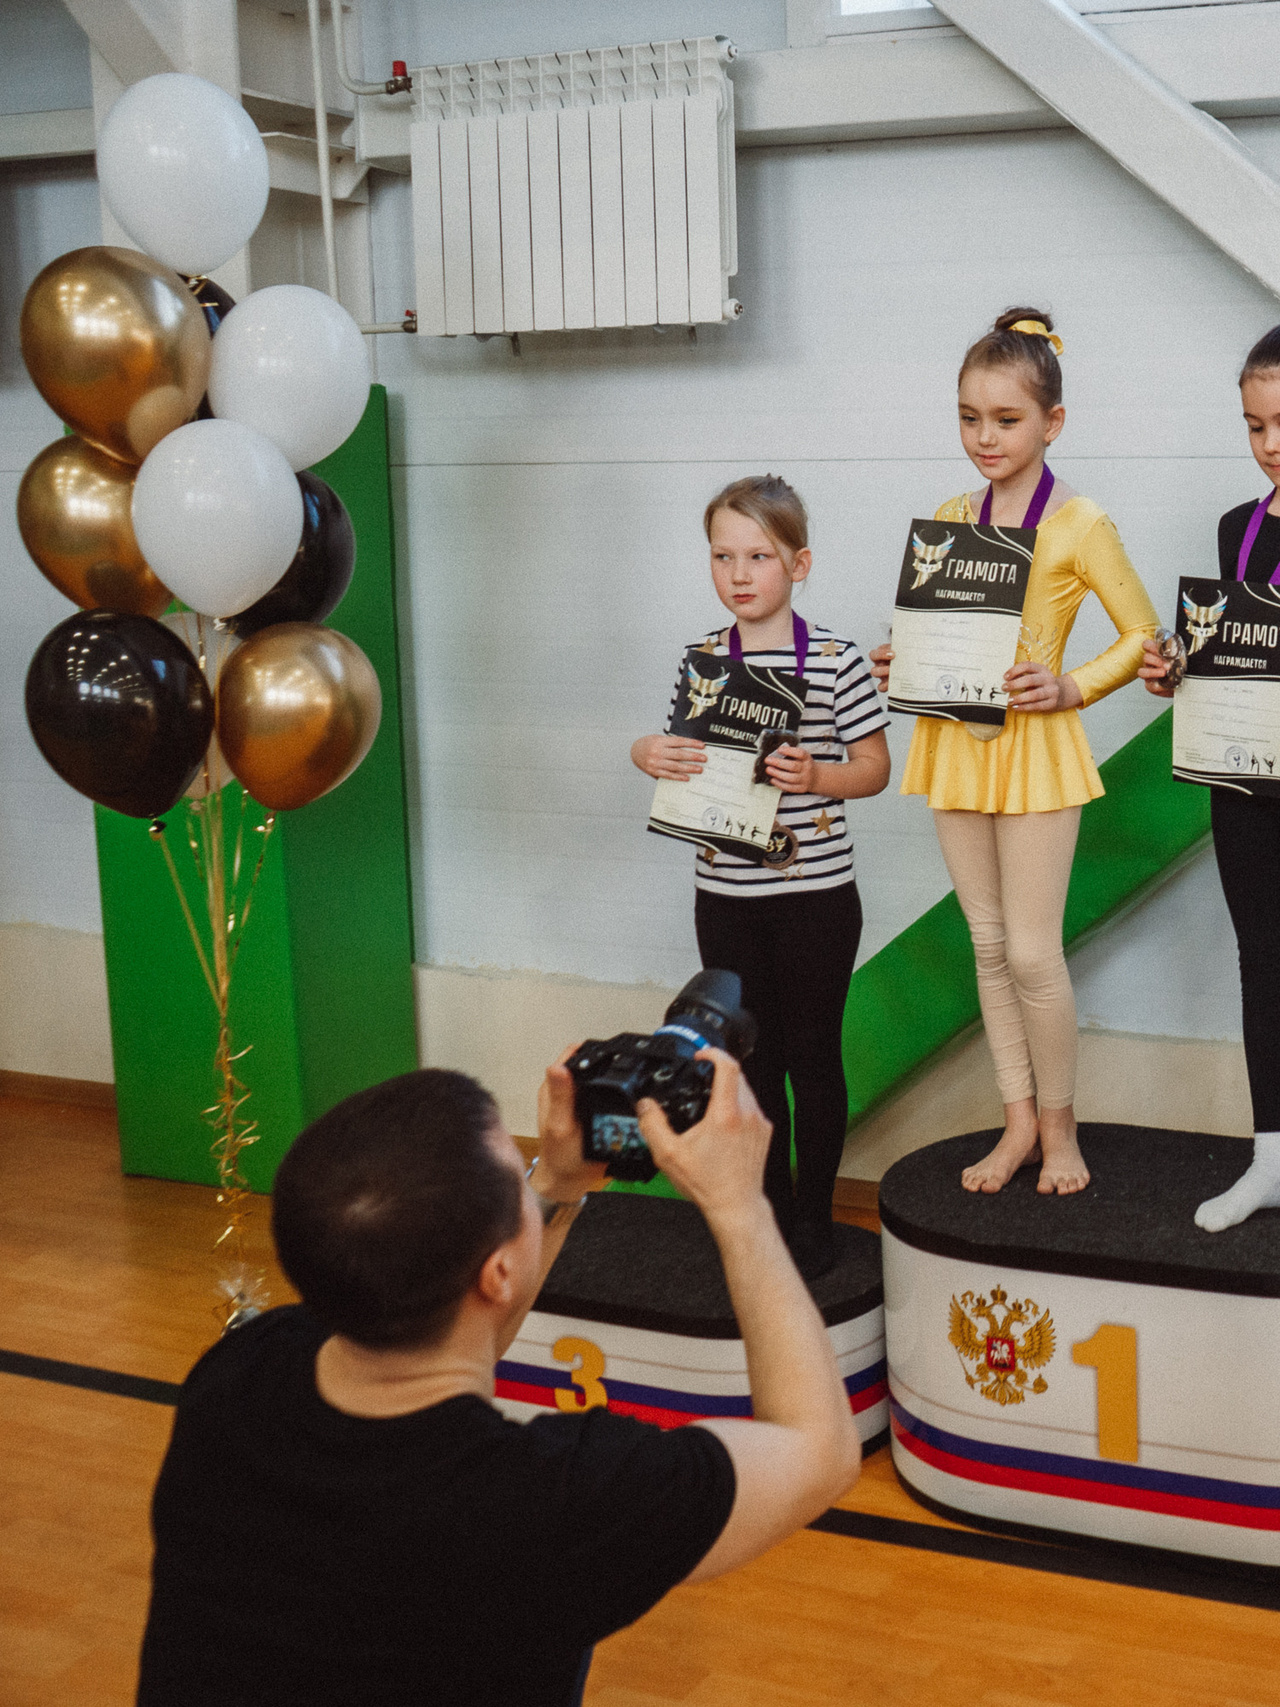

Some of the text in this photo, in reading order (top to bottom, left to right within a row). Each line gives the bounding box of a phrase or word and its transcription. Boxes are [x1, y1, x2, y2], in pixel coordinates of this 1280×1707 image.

[945, 558, 1017, 584] ГРАМОТА
[935, 588, 985, 602] НАГРАЖДАЕТСЯ
[1213, 654, 1267, 670] НАГРАЖДАЕТСЯ
[720, 695, 789, 729] ГРАМОТА
[551, 1334, 608, 1413] 3
[1072, 1323, 1140, 1463] 1
